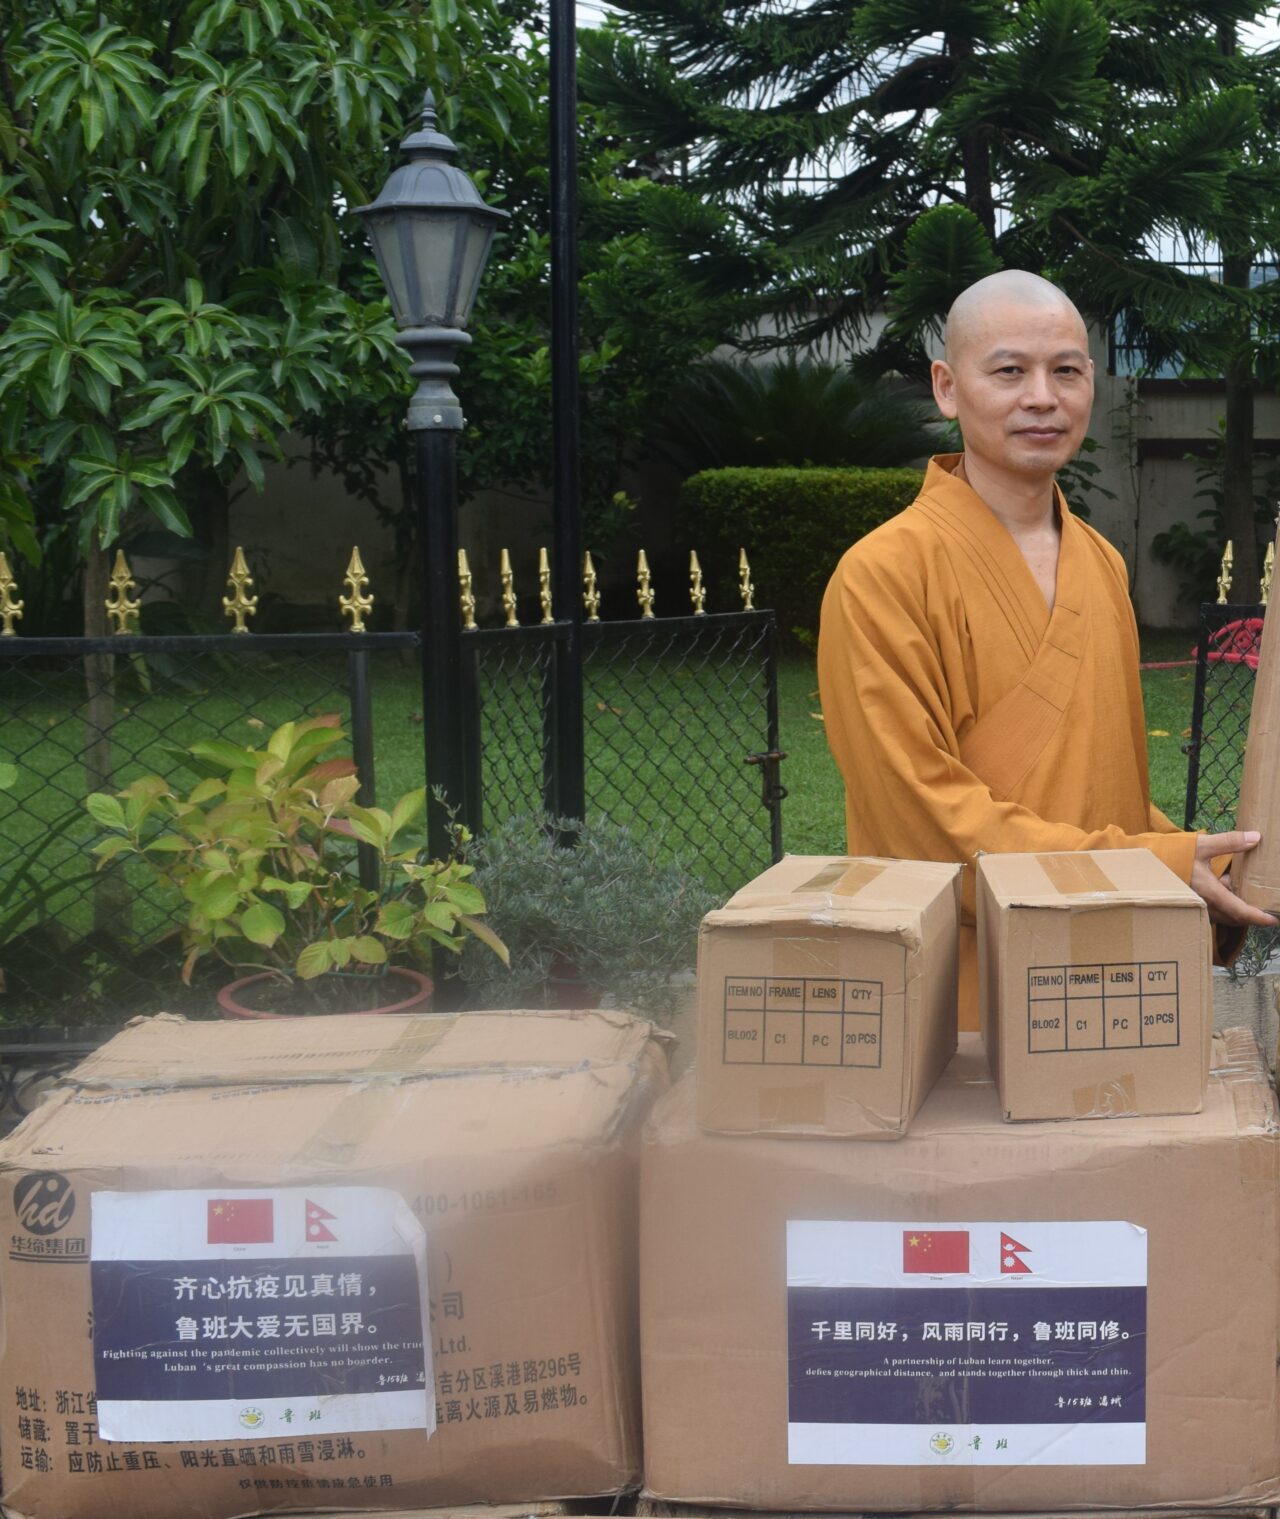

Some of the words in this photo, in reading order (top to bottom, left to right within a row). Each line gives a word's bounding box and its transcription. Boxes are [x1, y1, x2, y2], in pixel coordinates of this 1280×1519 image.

[1031, 976, 1050, 987] ITEM
[1051, 975, 1063, 986] NO
[1069, 973, 1100, 985] FRAME
[1110, 972, 1134, 983] LENS
[1147, 970, 1168, 982] Q'TY
[727, 985, 749, 997] ITEM
[749, 986, 762, 997] NO
[769, 986, 801, 998] FRAME
[812, 987, 837, 999] LENS
[851, 988, 872, 1000] Q'TY
[1076, 1020, 1088, 1031] C1
[1144, 1015, 1154, 1026] 20
[1156, 1013, 1175, 1024] PCS
[774, 1033, 787, 1044] C1
[845, 1034, 857, 1044] 20
[858, 1032, 877, 1044] PCS
[174, 1273, 377, 1300] 齐心抗疫见真情，
[175, 1312, 377, 1340] 鲁班大爱无国界。
[102, 1349, 148, 1360] Fighting
[150, 1349, 188, 1359] against
[191, 1348, 208, 1357] the
[211, 1347, 260, 1359] pandemic
[263, 1345, 325, 1357] collectively
[328, 1343, 349, 1353] will
[352, 1342, 379, 1351] show
[382, 1341, 400, 1350] the
[164, 1363, 197, 1372] Luban
[214, 1362, 240, 1373] great
[243, 1360, 306, 1373] compassion
[309, 1358, 328, 1368] has
[331, 1358, 344, 1367] no
[347, 1356, 393, 1367] boarder.
[892, 1357, 945, 1367] partnership
[946, 1356, 957, 1365] of
[958, 1356, 986, 1365] Luban
[988, 1356, 1012, 1365] learn
[1013, 1356, 1055, 1367] together.
[434, 1352, 582, 1394] 吉分区溪港路296号
[805, 1367, 832, 1376] defies
[834, 1367, 891, 1379] geographical
[893, 1368, 934, 1378] distance,
[938, 1368, 956, 1377] and
[958, 1368, 986, 1377] stands
[988, 1368, 1026, 1378] together
[1028, 1367, 1064, 1378] through
[1066, 1367, 1089, 1376] thick
[1091, 1367, 1108, 1376] and
[1110, 1367, 1132, 1376] thin.
